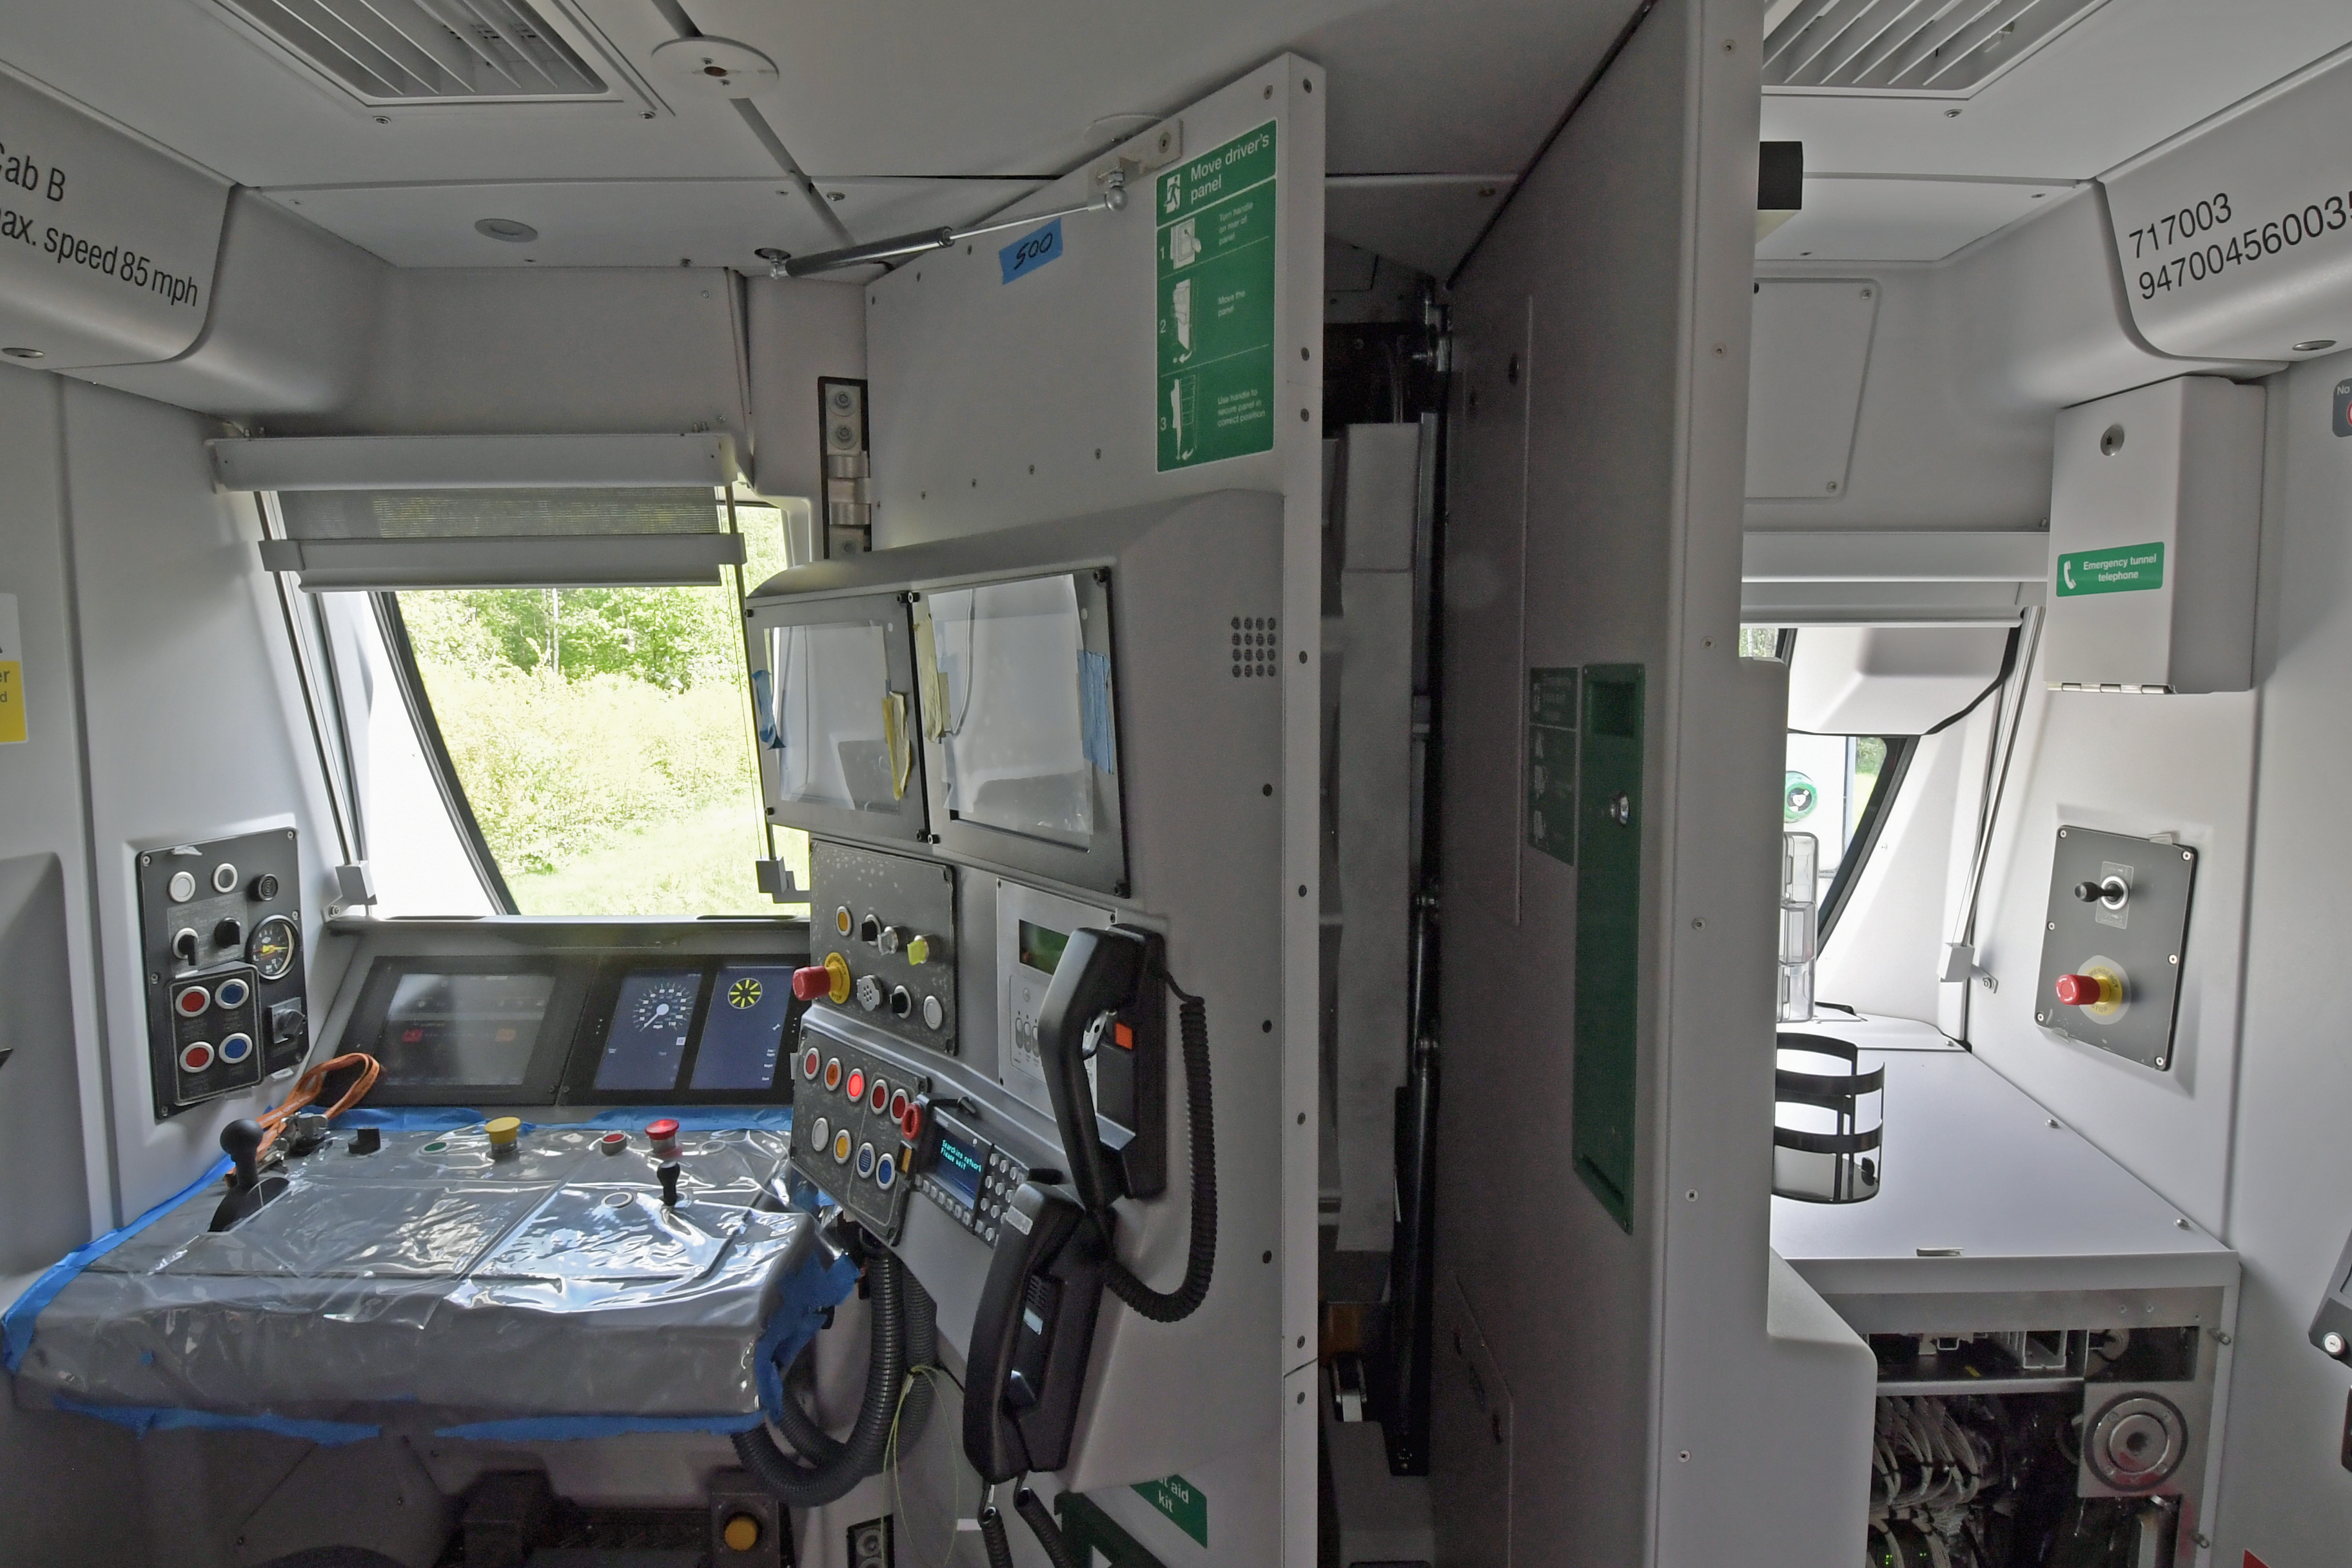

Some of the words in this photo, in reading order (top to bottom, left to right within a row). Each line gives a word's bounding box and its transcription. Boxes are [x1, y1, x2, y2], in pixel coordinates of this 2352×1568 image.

[1191, 157, 1222, 182] Move
[1225, 133, 1269, 165] driver's
[0, 143, 39, 191] ab
[46, 168, 66, 202] B
[1190, 173, 1222, 204] panel
[1233, 202, 1254, 217] handle
[2129, 192, 2232, 259] 717003
[1161, 246, 1165, 260] 1
[2139, 191, 2352, 300] 94700456003
[0, 209, 37, 246] ax.
[44, 227, 119, 276] speed
[119, 251, 151, 287] 85
[152, 269, 199, 307] mph
[1218, 294, 1235, 306] Move
[1218, 305, 1235, 318] panel
[1160, 318, 1166, 334] 2
[1218, 395, 1230, 406] Use
[1230, 390, 1251, 402] handle
[1218, 405, 1237, 416] secure
[1238, 400, 1255, 411] panel
[1160, 416, 1167, 431] 3
[1217, 415, 1239, 427] correct
[1239, 410, 1266, 422] position
[2082, 558, 2128, 571] Emergency
[2130, 553, 2157, 565] tunnel
[2098, 571, 2139, 583] telephone
[1158, 1489, 1173, 1513] kit
[1171, 1482, 1190, 1504] aid
